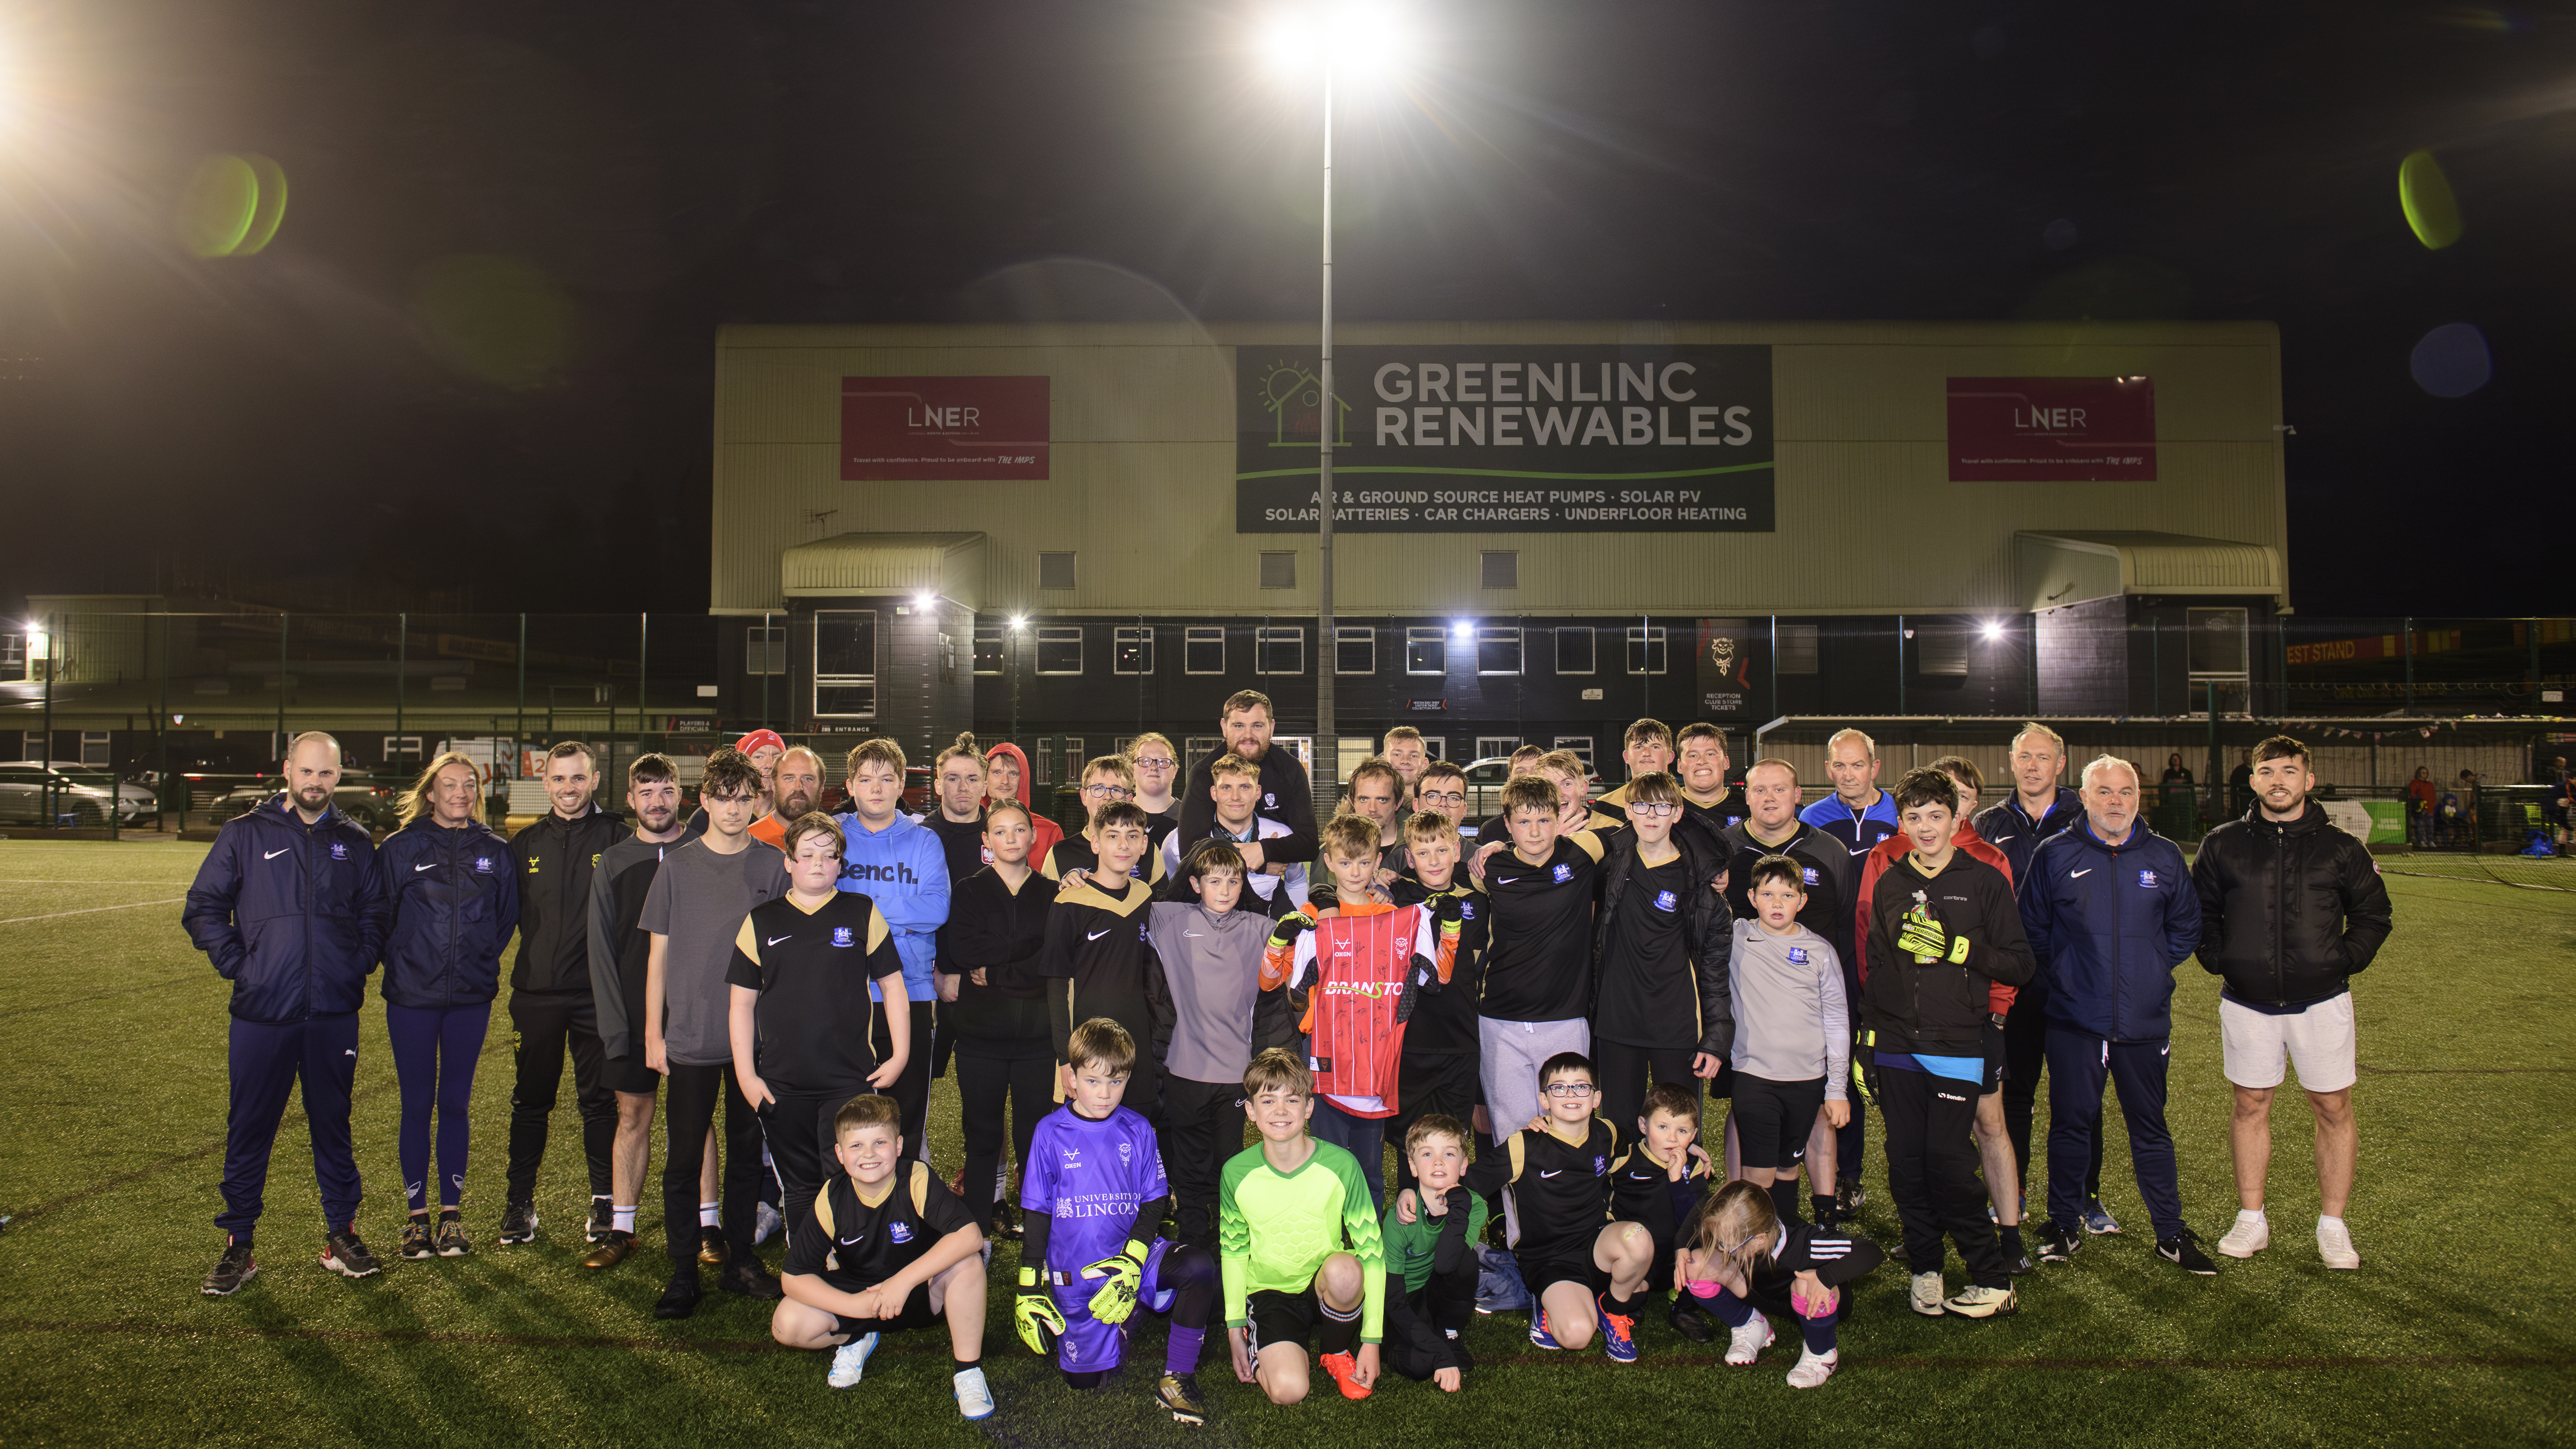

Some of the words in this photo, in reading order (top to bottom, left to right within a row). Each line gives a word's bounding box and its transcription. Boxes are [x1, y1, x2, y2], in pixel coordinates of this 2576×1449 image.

[1373, 362, 1698, 402] GREENLINC
[908, 403, 979, 429] LNER
[1377, 406, 1753, 447] RENEWABLES
[2015, 404, 2086, 430] LNER
[998, 456, 1012, 464] THE
[1014, 456, 1035, 464] IMPS
[1311, 491, 1338, 503] AR
[1342, 491, 1354, 503] &
[1360, 491, 1428, 503] GROUND
[1433, 491, 1498, 503] SOURCE
[1504, 491, 1543, 503] HEAT
[1549, 491, 1605, 503] PUMPS
[1620, 491, 1674, 503] SOLAR
[1680, 491, 1701, 503] PV
[1265, 508, 1319, 521] SOLAR
[1332, 508, 1409, 521] ATTERIES
[1424, 508, 1457, 521] CAR
[1463, 508, 1550, 521] CHARGERS
[1565, 508, 1673, 520] UNDERFLOOR
[1678, 508, 1747, 521] HEATING
[2287, 645, 2309, 664] EST
[2313, 640, 2355, 662] STAND
[1325, 981, 1404, 999] BRANSTO
[1074, 1193, 1132, 1203] UNIVERSITY
